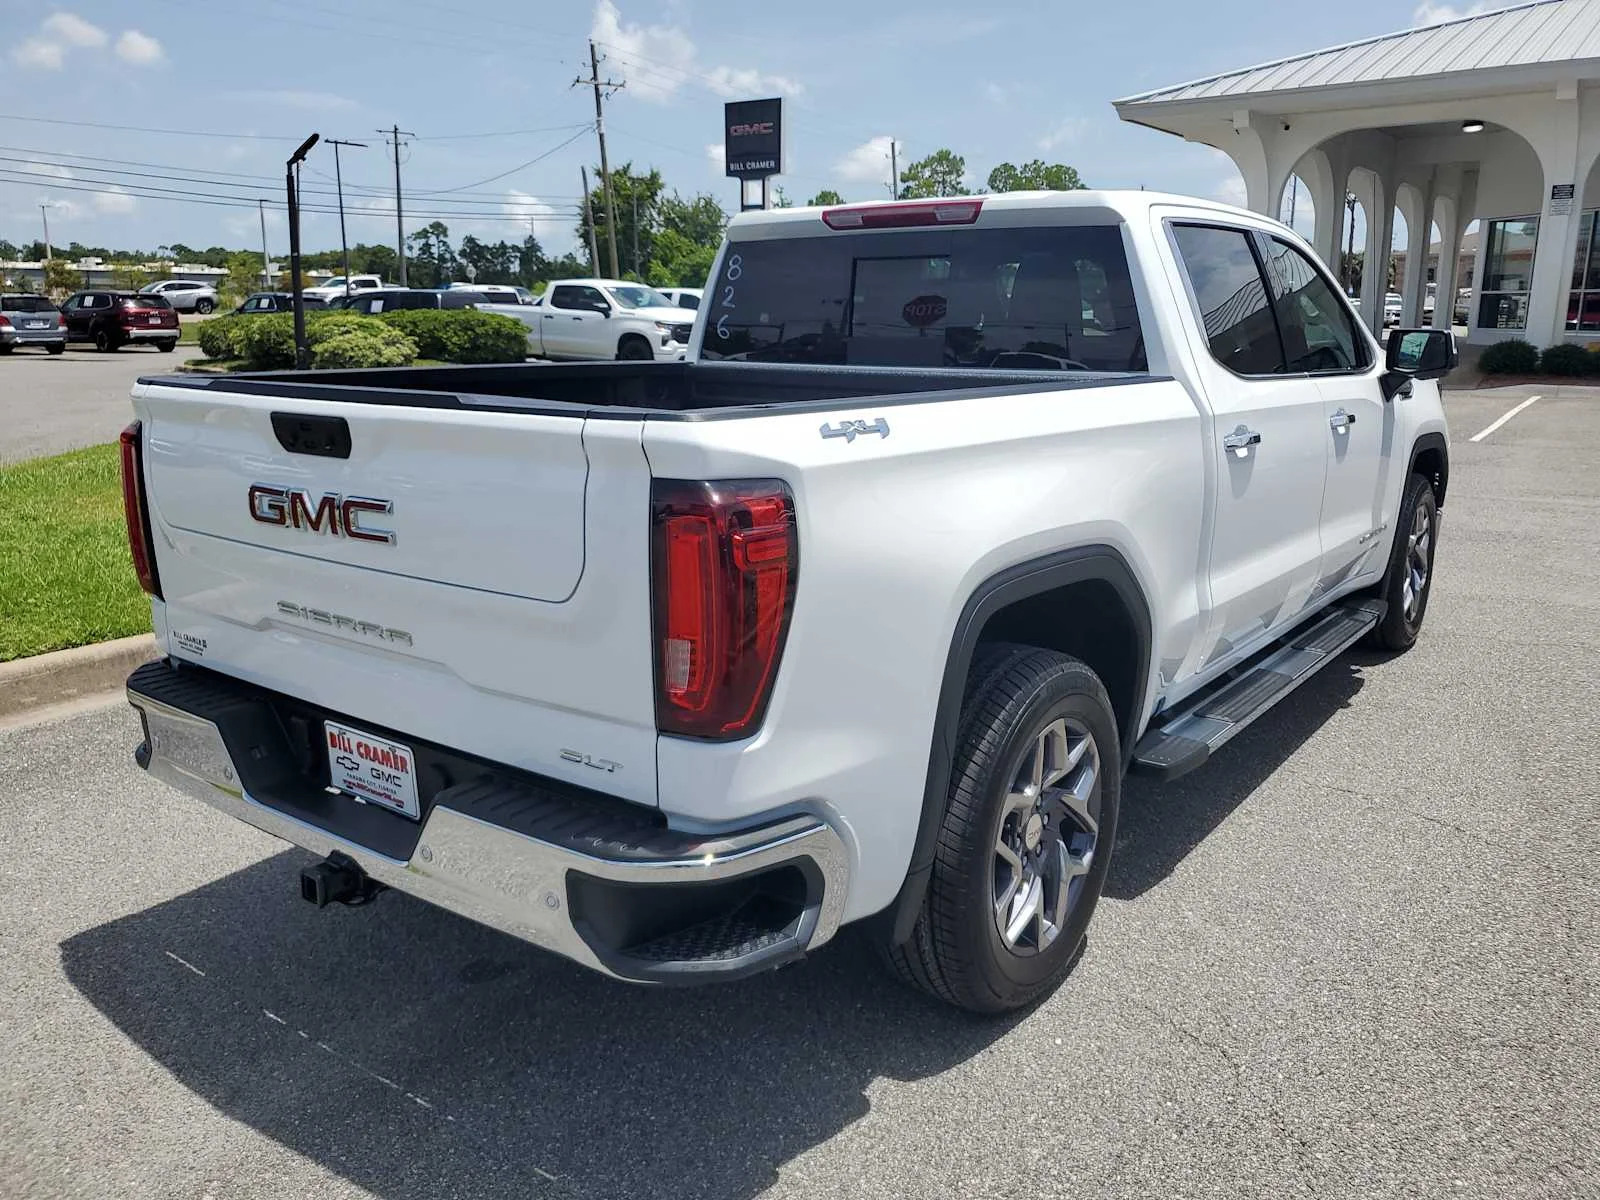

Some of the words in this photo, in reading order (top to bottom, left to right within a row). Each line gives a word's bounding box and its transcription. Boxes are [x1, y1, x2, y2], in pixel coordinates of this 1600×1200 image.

[730, 122, 774, 136] GMC
[729, 162, 745, 171] BILL
[746, 160, 776, 170] CRAMER
[248, 482, 397, 546] GMC
[276, 600, 414, 648] SIERRA
[328, 731, 354, 755] BILL
[356, 741, 409, 775] CRAMER
[559, 748, 624, 772] SLT
[370, 767, 402, 788] GMC
